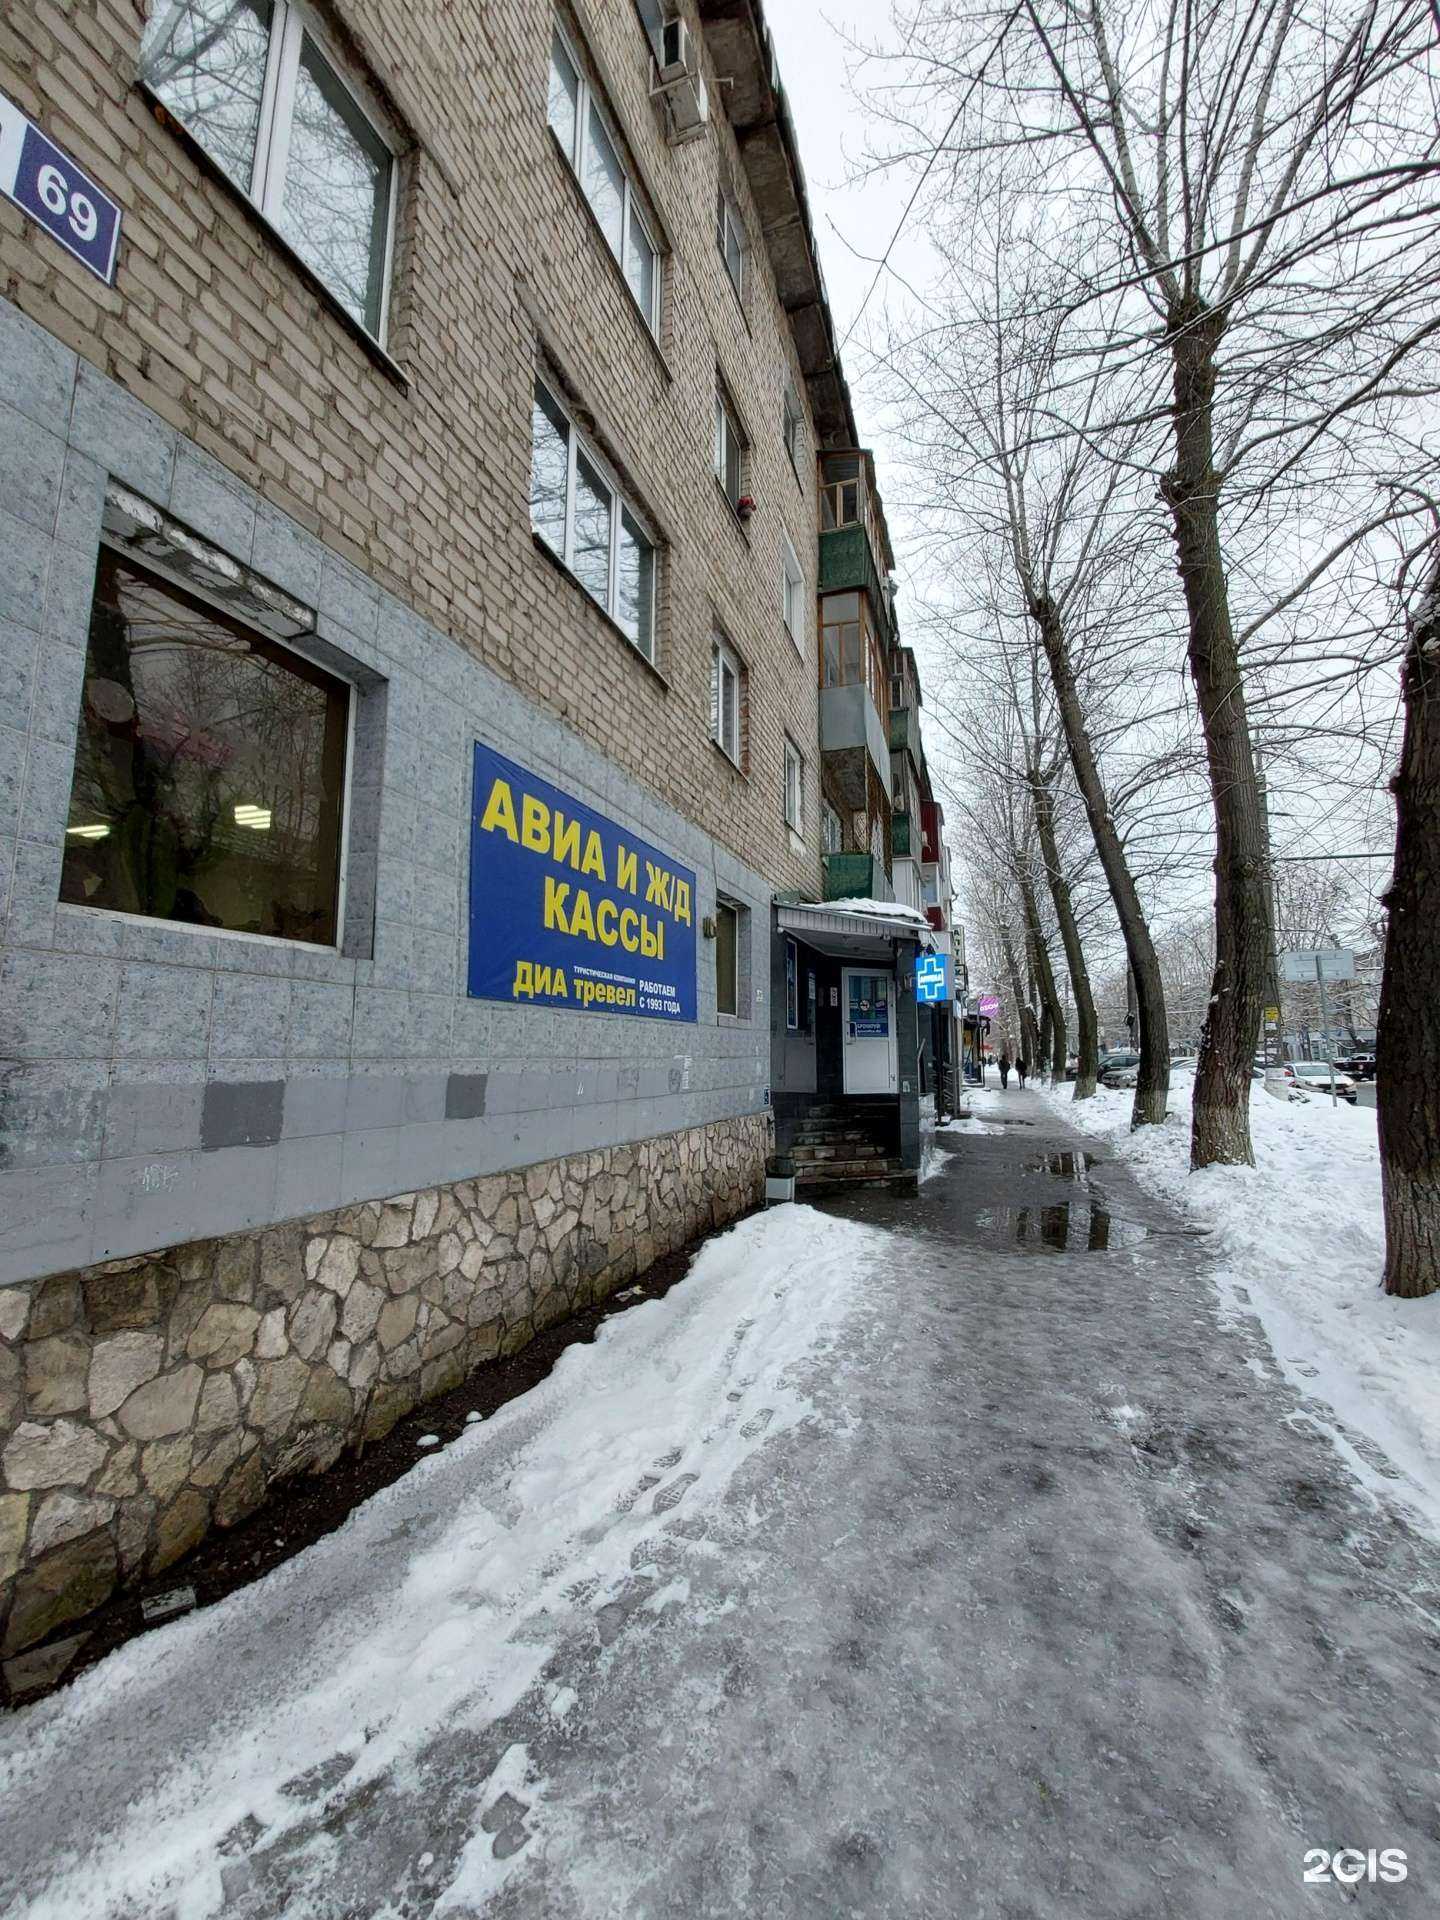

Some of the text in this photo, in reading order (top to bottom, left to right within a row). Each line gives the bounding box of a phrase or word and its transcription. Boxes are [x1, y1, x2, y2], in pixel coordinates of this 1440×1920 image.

[37, 164, 98, 242] 69
[480, 778, 691, 928] АВИА И Ж/Д
[543, 875, 664, 961] КАССЫ
[512, 960, 636, 1009] ДИА тревел
[639, 980, 676, 997] РАБОТАЕМ
[639, 996, 681, 1015] С 1993 ГОДА
